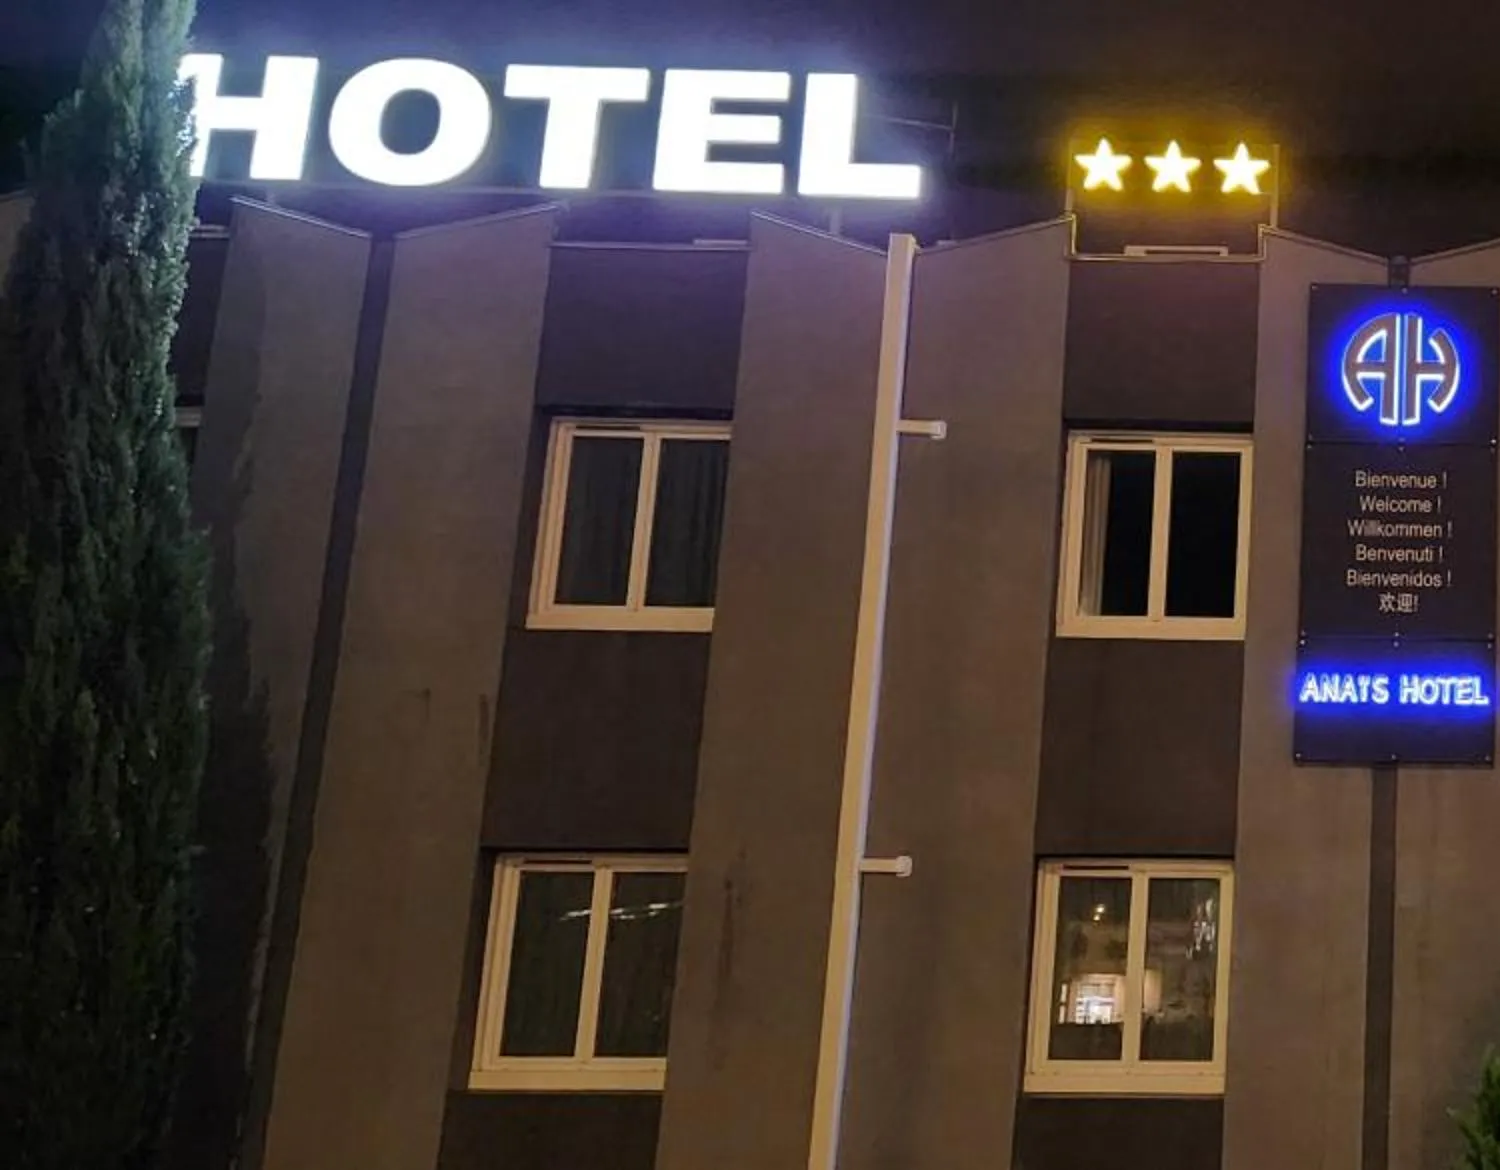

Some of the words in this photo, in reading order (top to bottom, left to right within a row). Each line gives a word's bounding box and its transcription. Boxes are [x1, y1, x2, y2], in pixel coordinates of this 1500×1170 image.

[174, 53, 922, 199] HOTEL
[1355, 469, 1437, 489] Bienvenue
[1360, 495, 1432, 513] Welcome
[1347, 519, 1442, 537] Willkommen
[1355, 543, 1433, 562] Benvenuti
[1347, 568, 1442, 588] Bienvenidos
[1400, 674, 1490, 705] HOTEL
